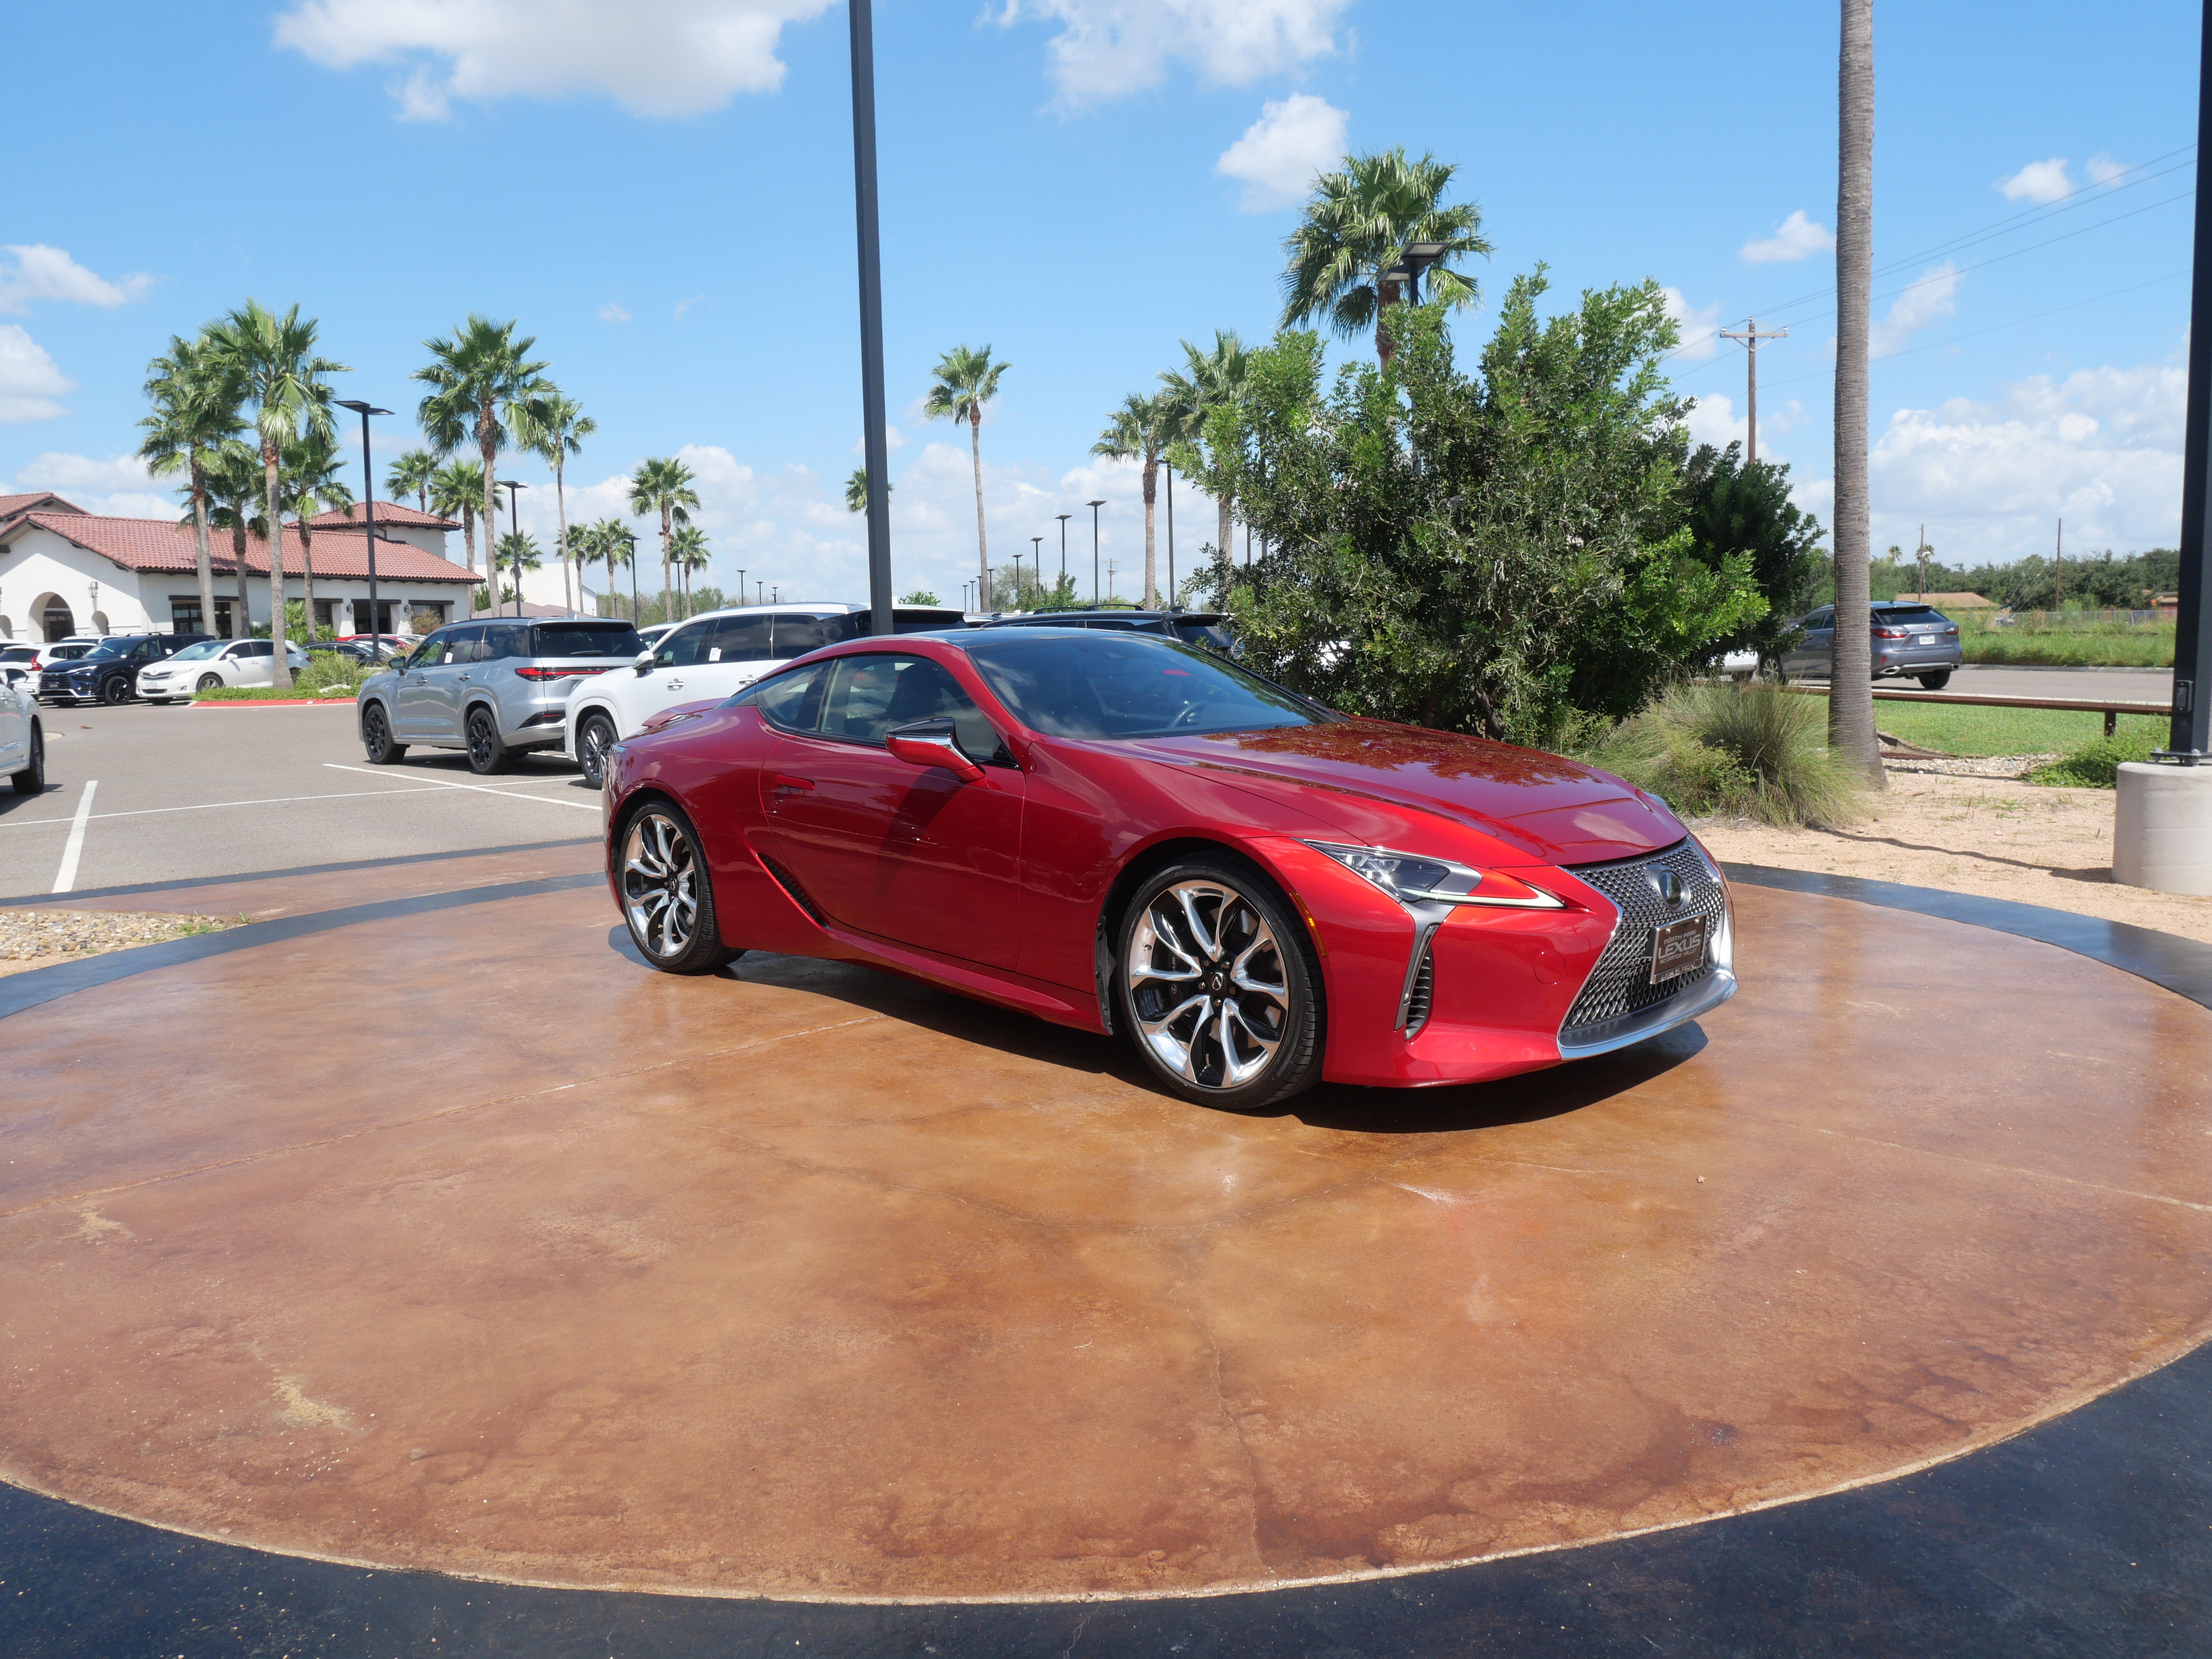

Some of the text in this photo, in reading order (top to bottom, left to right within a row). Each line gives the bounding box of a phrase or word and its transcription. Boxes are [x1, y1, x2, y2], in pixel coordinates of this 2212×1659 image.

[1664, 929, 1697, 945] NORTH PARK
[1658, 934, 1700, 959] LEXUS
[1666, 953, 1682, 962] GRANDE
[1683, 948, 1697, 956] VALLEY
[1661, 968, 1680, 980] LEXUS
